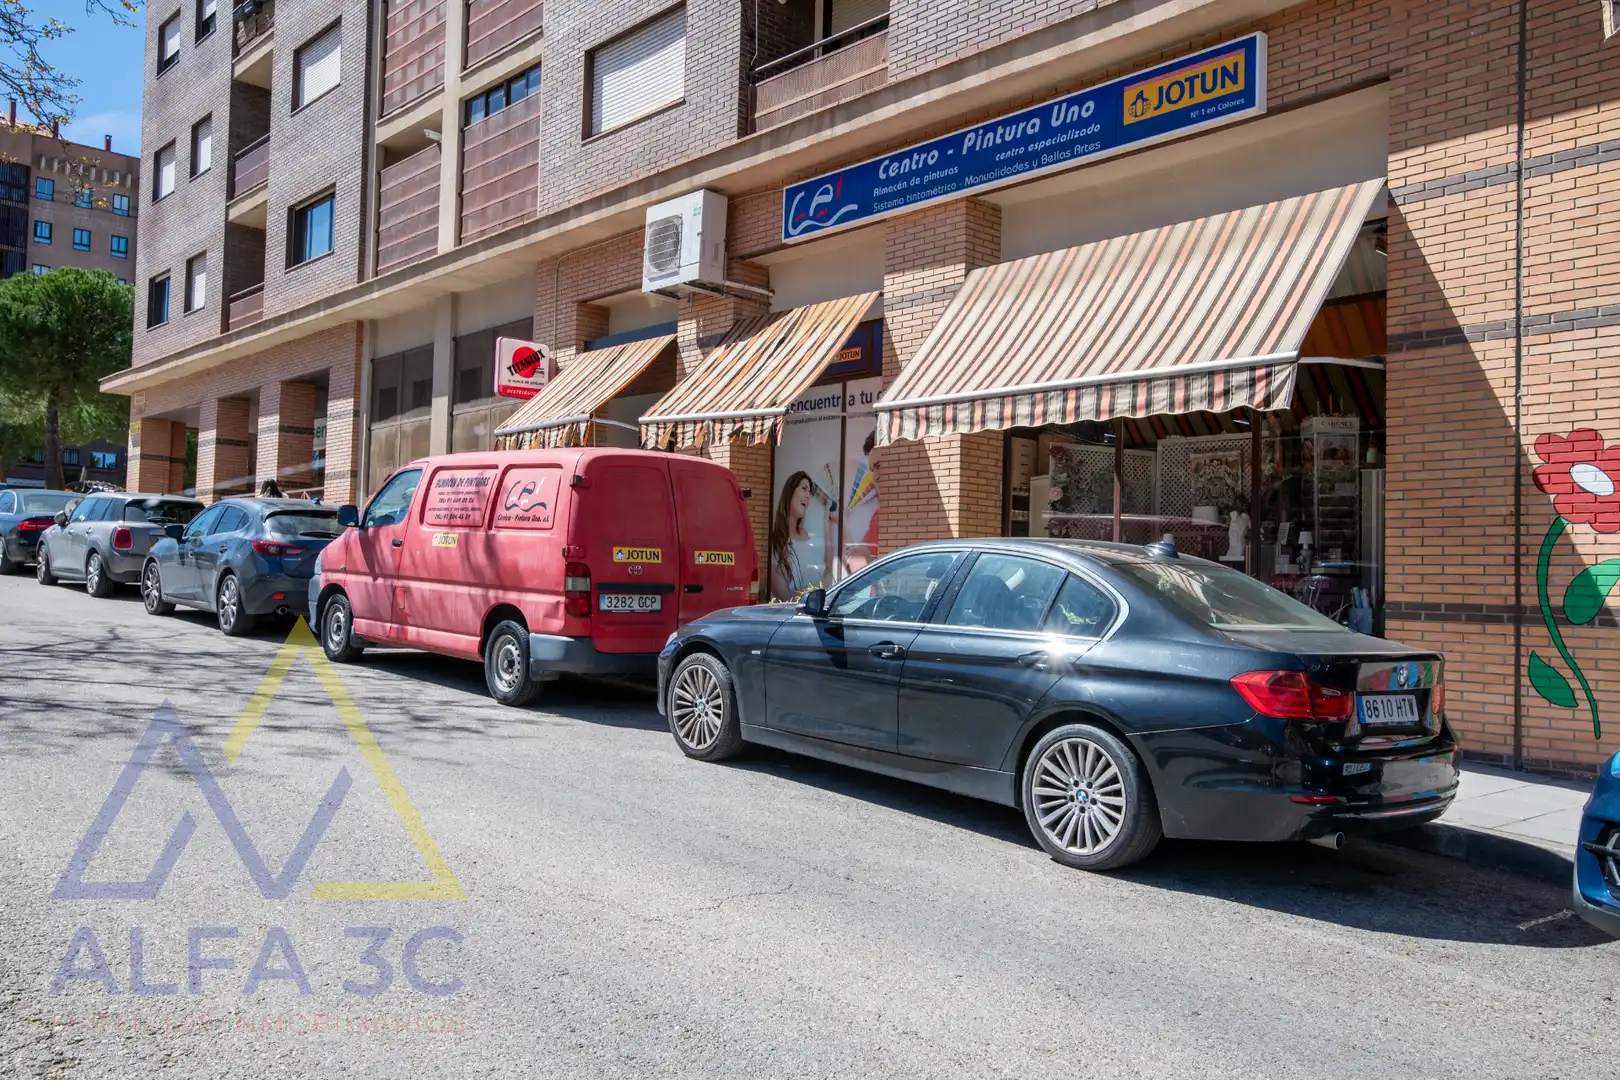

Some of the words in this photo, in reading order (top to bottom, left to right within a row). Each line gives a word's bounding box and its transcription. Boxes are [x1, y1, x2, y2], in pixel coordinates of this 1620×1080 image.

[1154, 60, 1239, 111] JOTUN
[1207, 106, 1216, 115] en
[1217, 97, 1245, 111] Colores
[878, 149, 939, 180] Centro
[962, 117, 1041, 155] Pintura
[1051, 100, 1095, 127] Uno
[995, 147, 1025, 161] centro
[1028, 123, 1101, 152] especializado
[872, 196, 905, 214] Sistema
[906, 182, 957, 204] tintométrico
[964, 161, 1030, 187] Manualidades
[1032, 159, 1039, 168] y
[1041, 149, 1071, 165] Bellas
[1074, 140, 1101, 156] Artes
[909, 175, 921, 187] de
[923, 165, 959, 185] pinturas
[507, 348, 545, 376] TITANLUX
[839, 350, 860, 360] JOTUN
[860, 389, 873, 405] tu
[514, 514, 531, 522] Pintura
[438, 535, 457, 545] JOTUN
[626, 549, 660, 561] JOTUN
[705, 552, 733, 563] JOTUN
[606, 596, 634, 609] 3282
[638, 596, 657, 608] GCP
[1365, 699, 1394, 719] 8610
